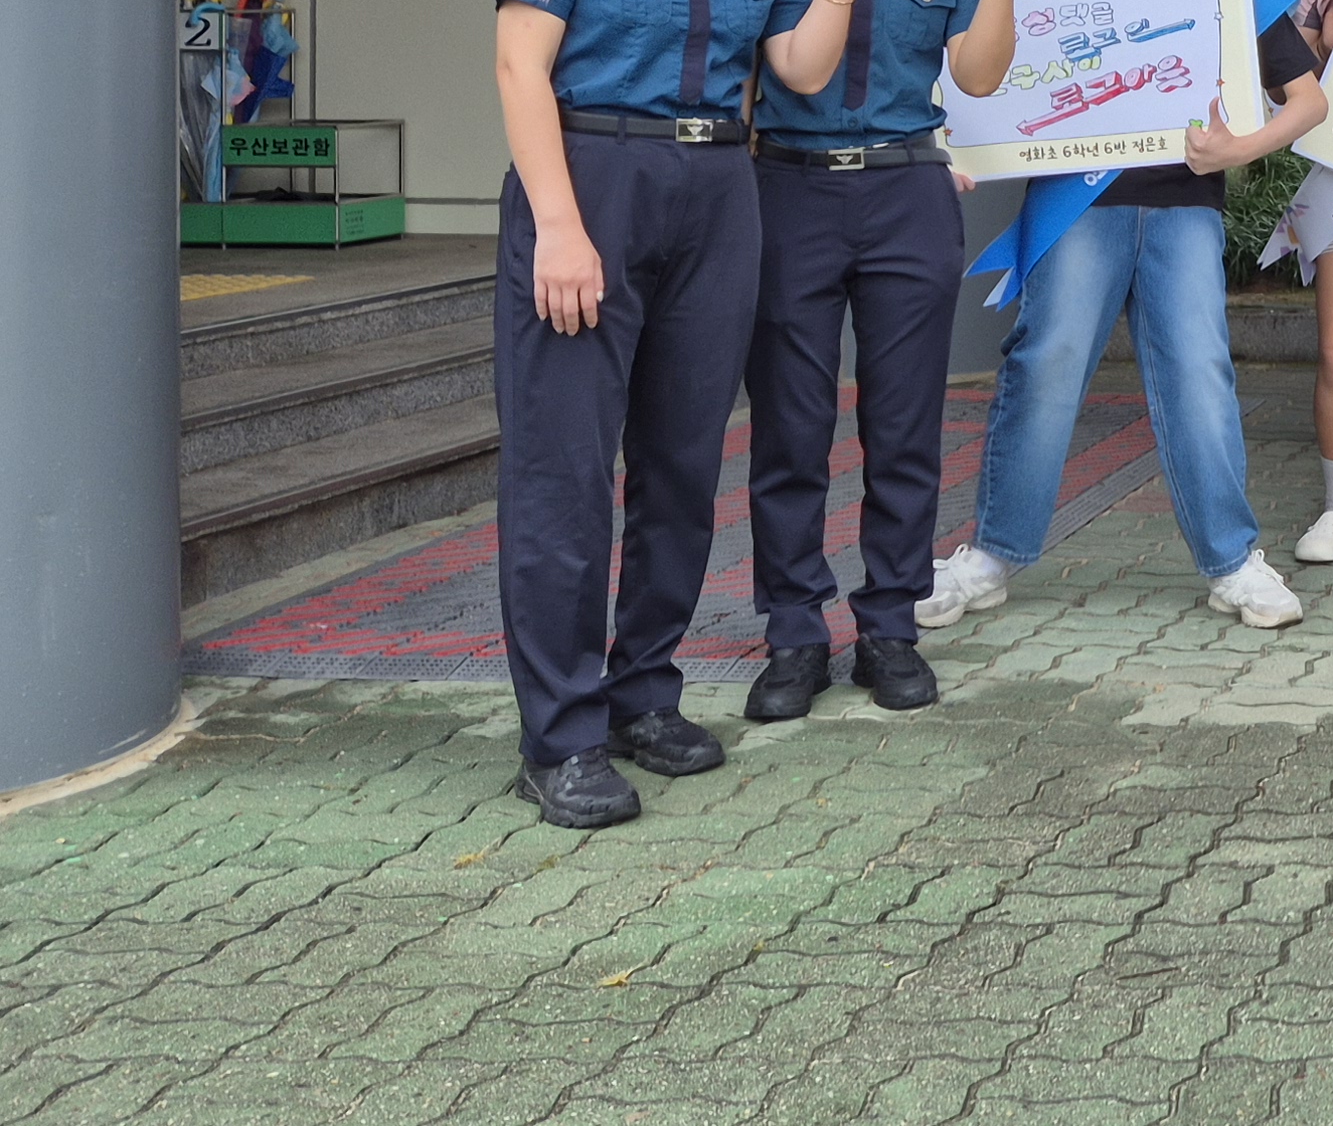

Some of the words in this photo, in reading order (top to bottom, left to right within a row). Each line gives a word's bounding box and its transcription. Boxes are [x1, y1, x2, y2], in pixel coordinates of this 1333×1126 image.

[229, 137, 330, 157] 우산보관함
[1019, 146, 1058, 163] 영화초
[1062, 143, 1100, 159] 6학년
[1103, 141, 1127, 155] 6반
[1132, 136, 1168, 153] 정은호
